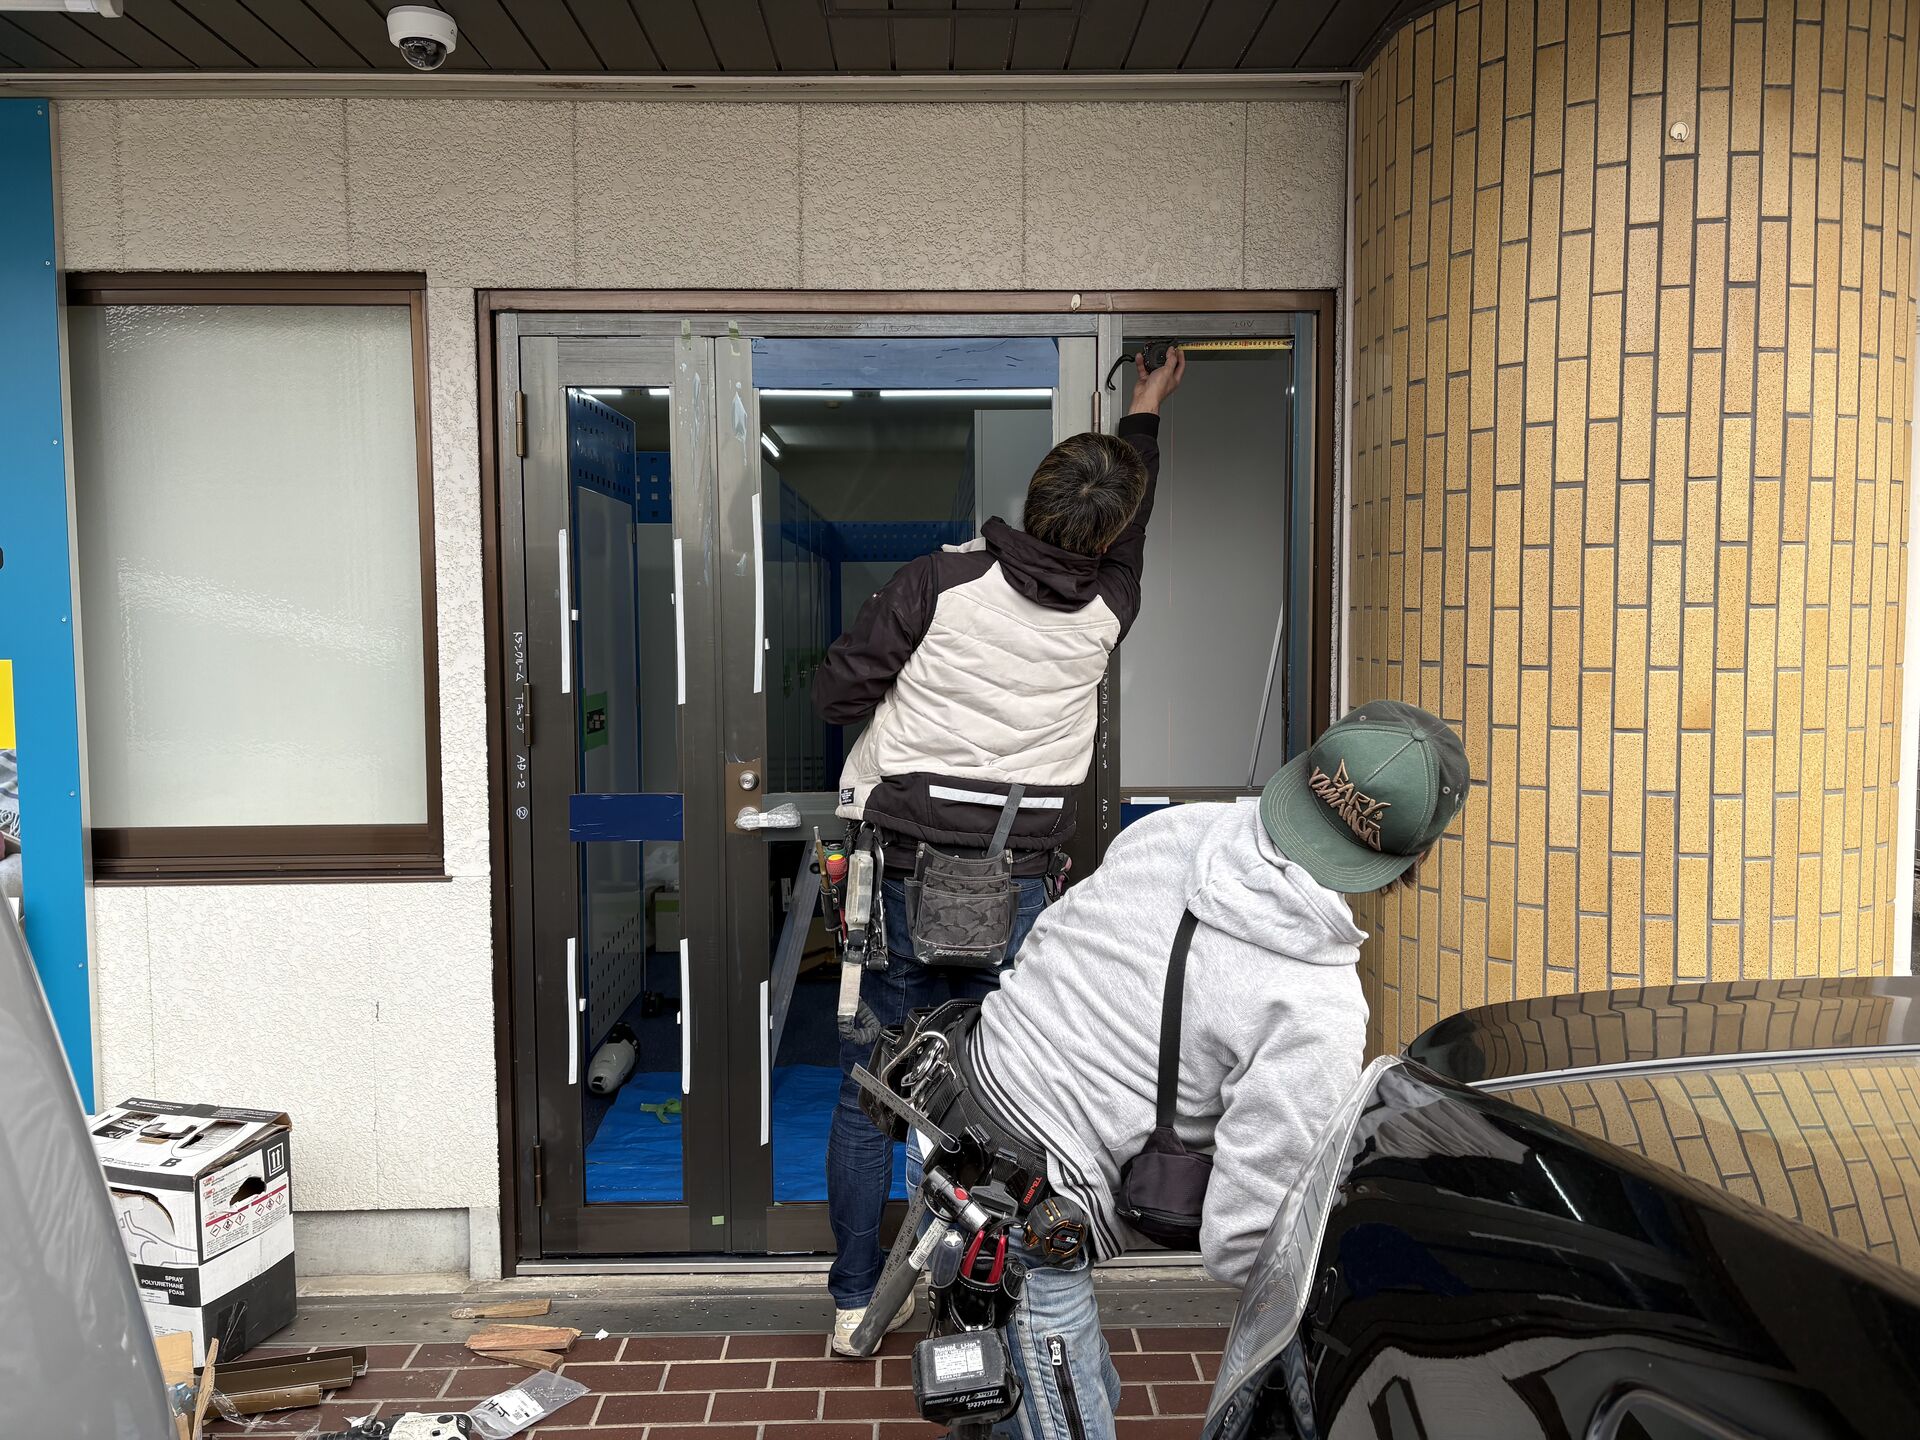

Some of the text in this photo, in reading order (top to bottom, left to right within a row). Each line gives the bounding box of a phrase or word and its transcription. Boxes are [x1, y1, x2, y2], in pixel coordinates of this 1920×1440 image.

[141, 1279, 184, 1289] POLYURETHANE
[164, 1275, 184, 1283] SPRAY
[966, 1397, 1004, 1409] makita
